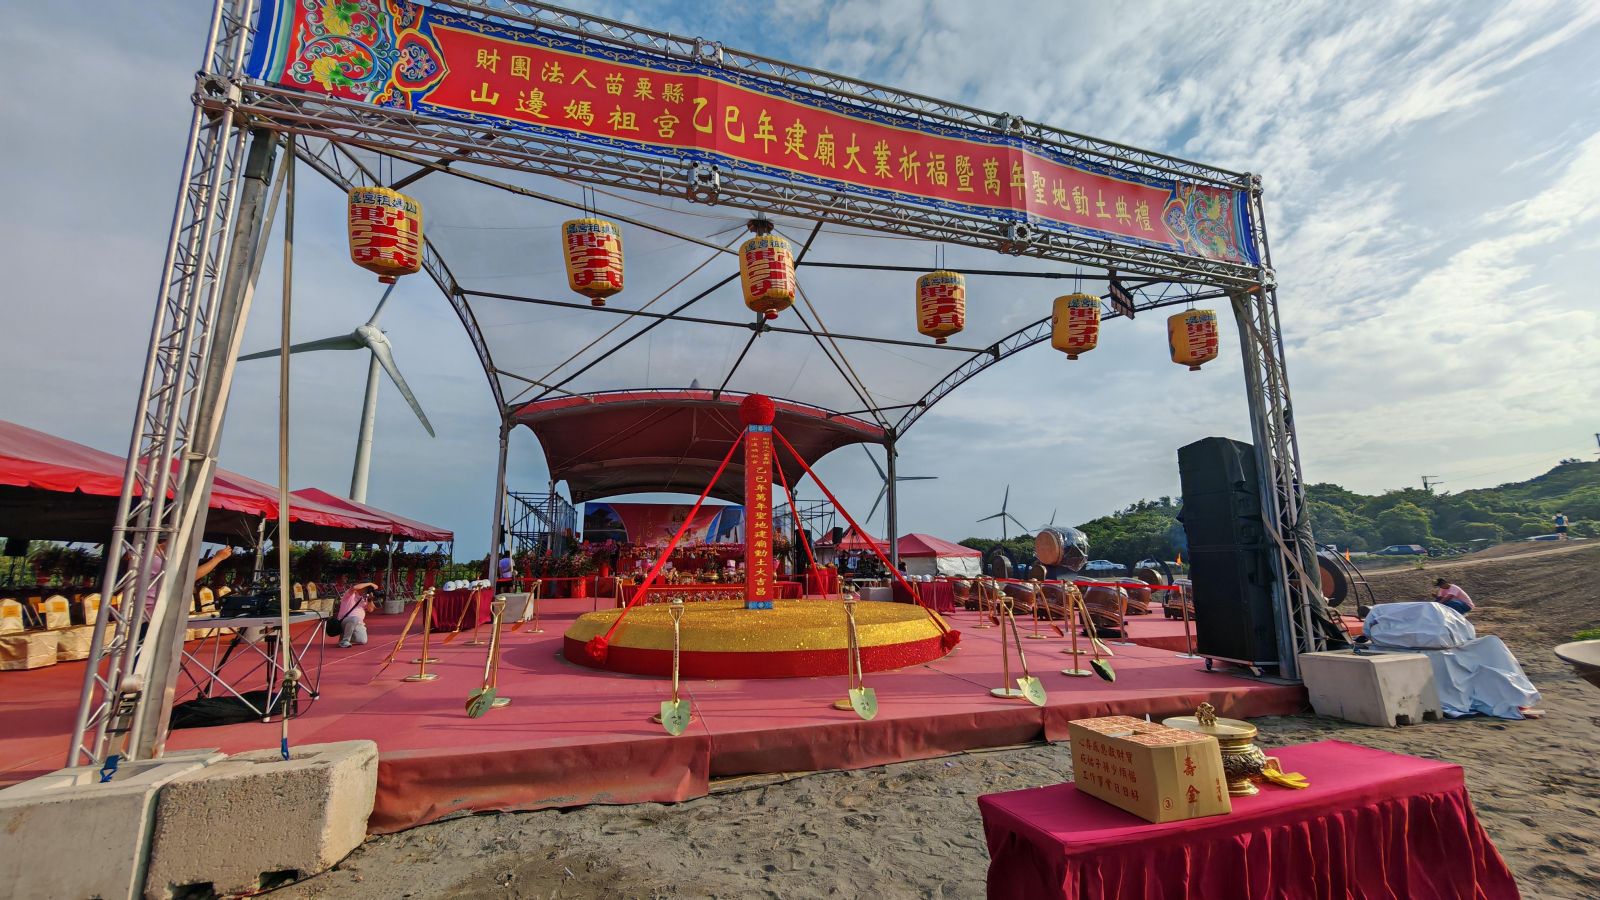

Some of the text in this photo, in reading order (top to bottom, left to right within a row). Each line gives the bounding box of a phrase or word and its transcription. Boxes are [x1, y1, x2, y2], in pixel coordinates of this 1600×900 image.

[475, 48, 684, 105] 財團法人苗栗縣
[470, 81, 680, 139] 山邊媽祖宮
[692, 97, 1154, 231] 乙巳年建廟大業祈福暨萬年聖地動土典禮
[754, 466, 768, 596] 乙巳年萬年聖地建廟動土大吉昌
[1183, 757, 1200, 803] 壽金
